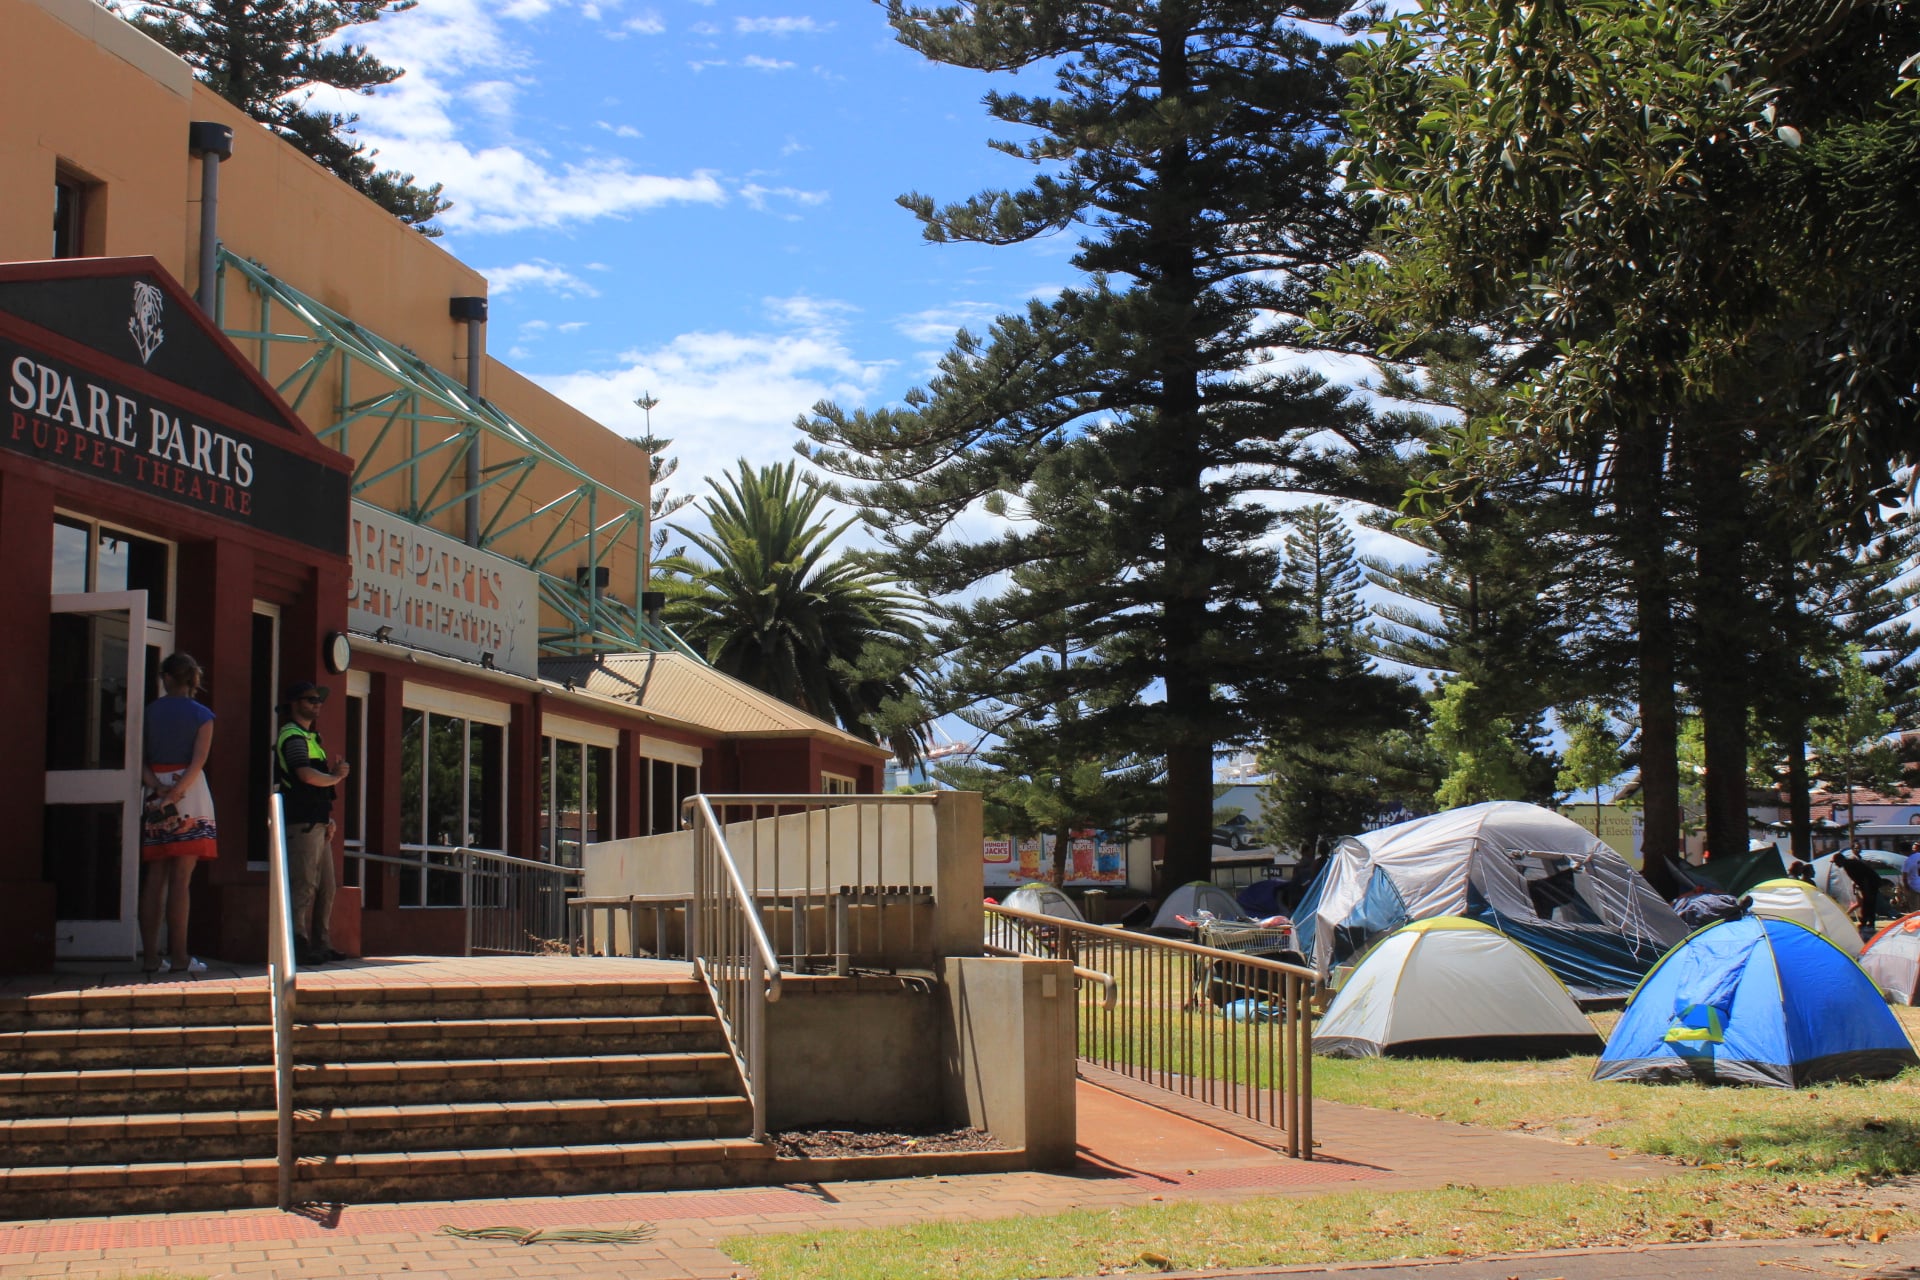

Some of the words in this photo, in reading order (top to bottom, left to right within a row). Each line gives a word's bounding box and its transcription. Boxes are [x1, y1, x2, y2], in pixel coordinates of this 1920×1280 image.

[9, 356, 138, 448] SPARE
[149, 407, 254, 488] PARTS
[11, 411, 126, 474] PUPPET
[135, 454, 252, 516] THEATRE
[408, 538, 503, 611] PARTS
[402, 595, 502, 651] THEATRE
